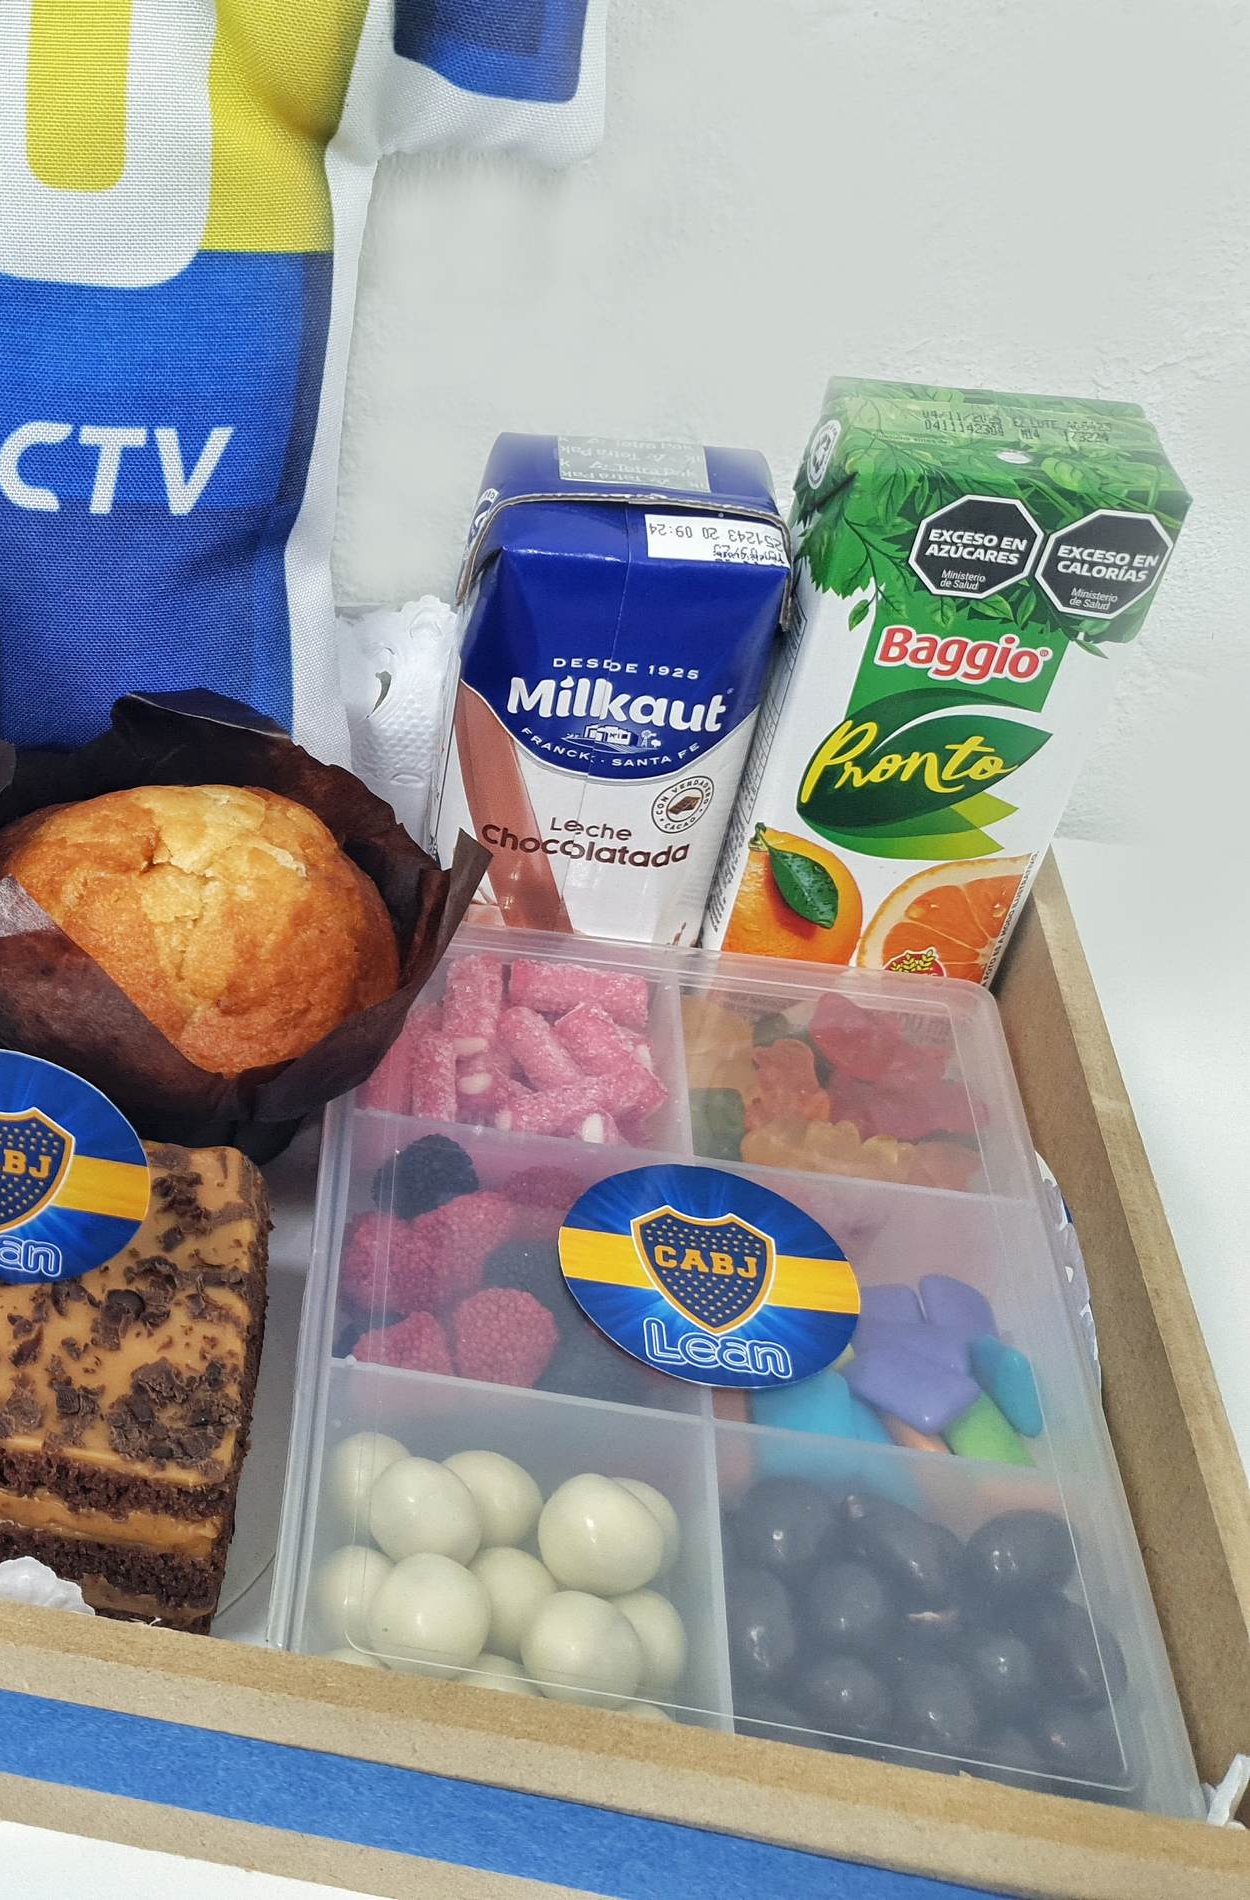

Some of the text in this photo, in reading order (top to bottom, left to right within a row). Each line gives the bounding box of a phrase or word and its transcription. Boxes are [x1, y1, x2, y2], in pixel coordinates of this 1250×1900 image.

[649, 523, 693, 539] 09:24
[702, 527, 719, 540] 20
[928, 529, 1028, 551] EXCESO EN
[925, 543, 1020, 565] AZÚCARES
[1057, 545, 1159, 568] EXCESO EN
[941, 569, 986, 583] Ministerio
[1057, 560, 1149, 582] CALORÍAS
[940, 579, 979, 591] de Salud
[1070, 587, 1118, 603] Ministerio
[1069, 597, 1110, 610] de Salud
[877, 626, 1042, 681] Baggio
[553, 657, 700, 680] DESDE 1925
[506, 674, 727, 732] Milkaut
[612, 755, 672, 767] SANTA
[677, 742, 700, 760] FE
[801, 720, 1020, 804] Pronto
[655, 779, 711, 816] CON VERDADERO
[550, 817, 632, 841] Leche
[663, 816, 696, 831] CACAO
[481, 823, 690, 868] Chocolatada
[653, 1244, 758, 1279] CABJ
[643, 1316, 793, 1379] Lean
